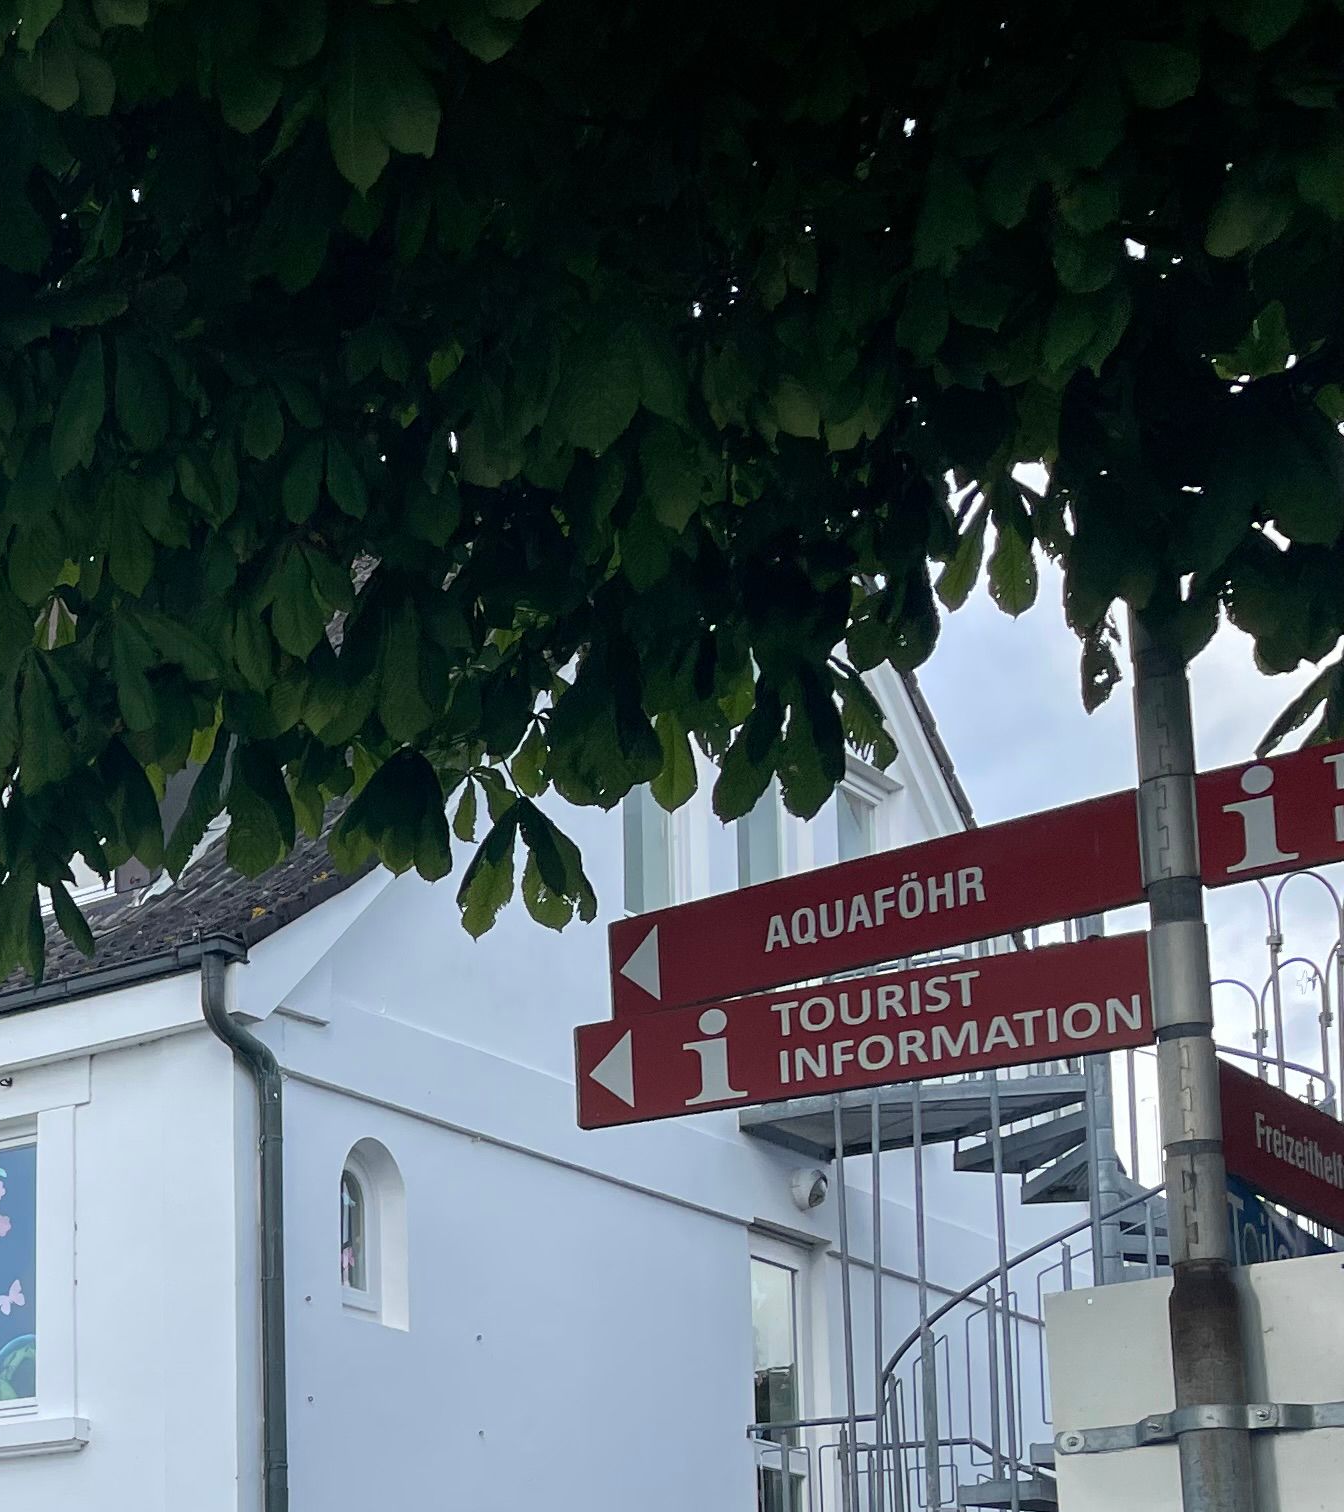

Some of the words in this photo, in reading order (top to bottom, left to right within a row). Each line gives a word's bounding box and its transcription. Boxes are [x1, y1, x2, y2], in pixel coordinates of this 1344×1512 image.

[765, 866, 987, 953] AQUAFÖHR
[770, 970, 980, 1037] TOURIST
[780, 994, 1143, 1084] INFORMATION
